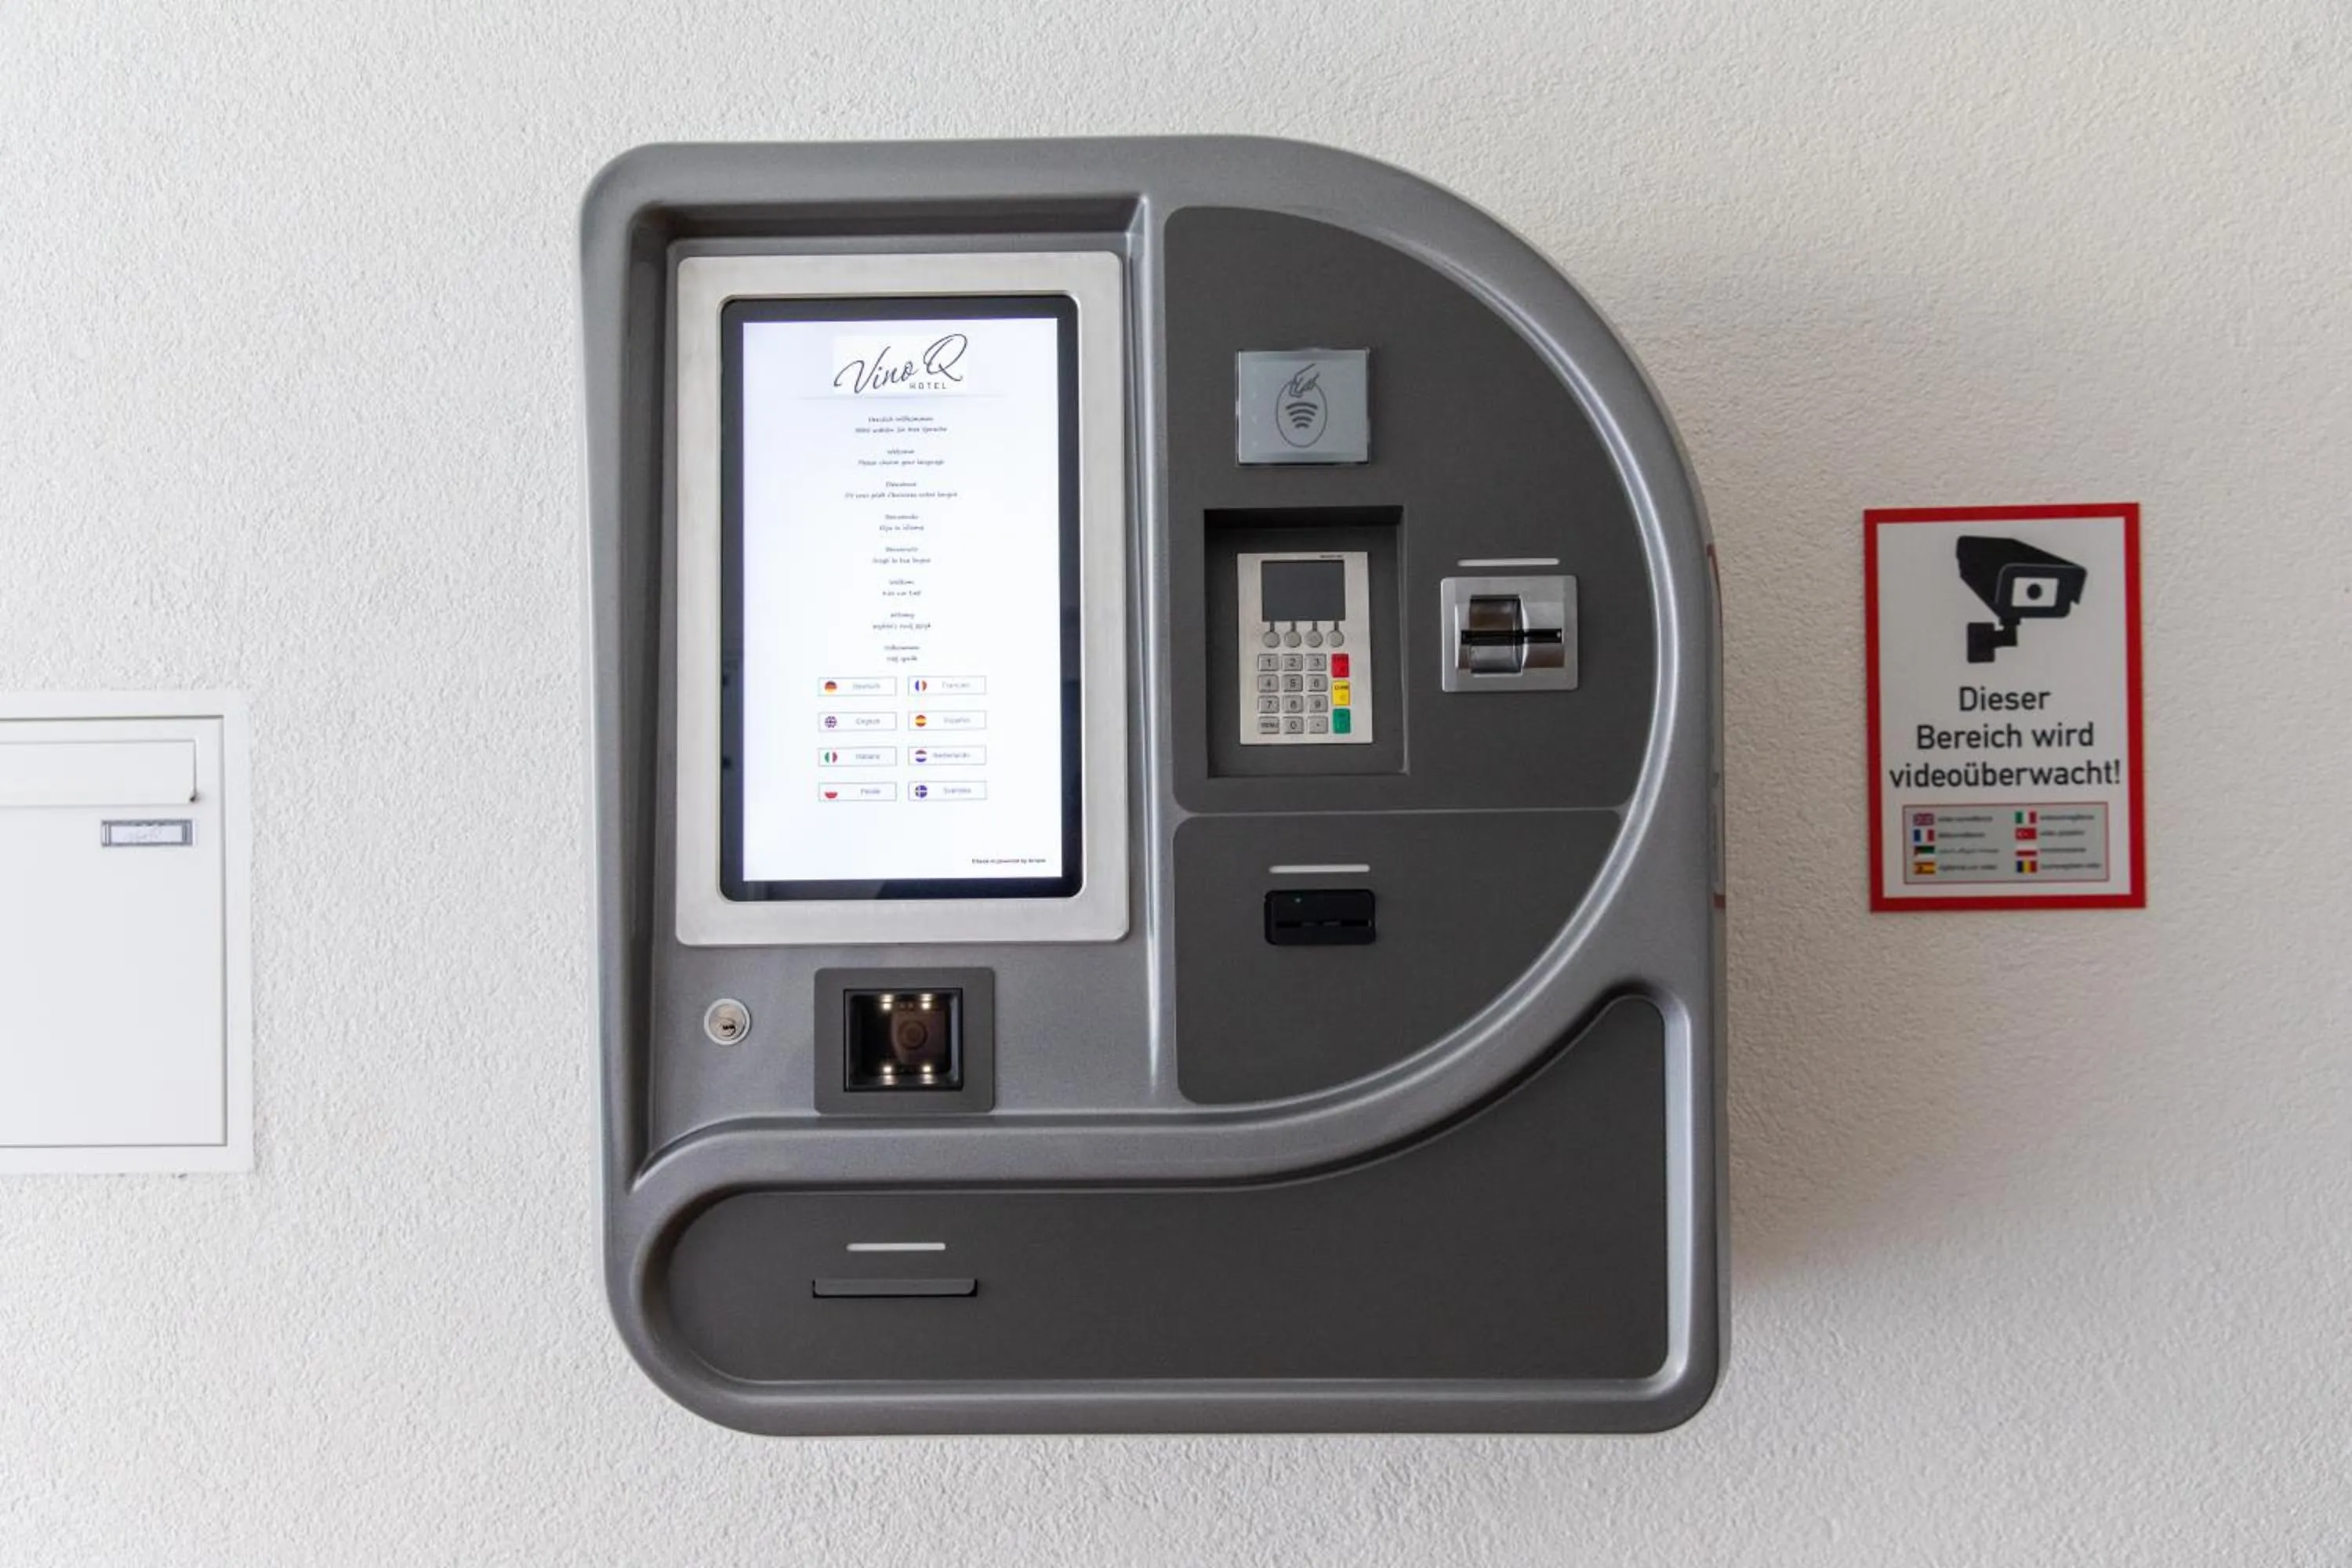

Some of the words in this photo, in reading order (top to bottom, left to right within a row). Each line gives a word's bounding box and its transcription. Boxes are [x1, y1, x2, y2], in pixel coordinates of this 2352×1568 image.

[833, 346, 918, 394] Vino
[924, 333, 967, 381] Q
[1290, 679, 1296, 688] 5
[1313, 679, 1319, 688] 6
[1266, 700, 1272, 709] 7
[1290, 700, 1297, 709] 8
[1959, 686, 2051, 711] Dieser
[1290, 720, 1297, 729] 0
[1917, 724, 2022, 750] Bereich
[2032, 721, 2094, 746] wird
[1889, 760, 2121, 788] videoüberwacht!
